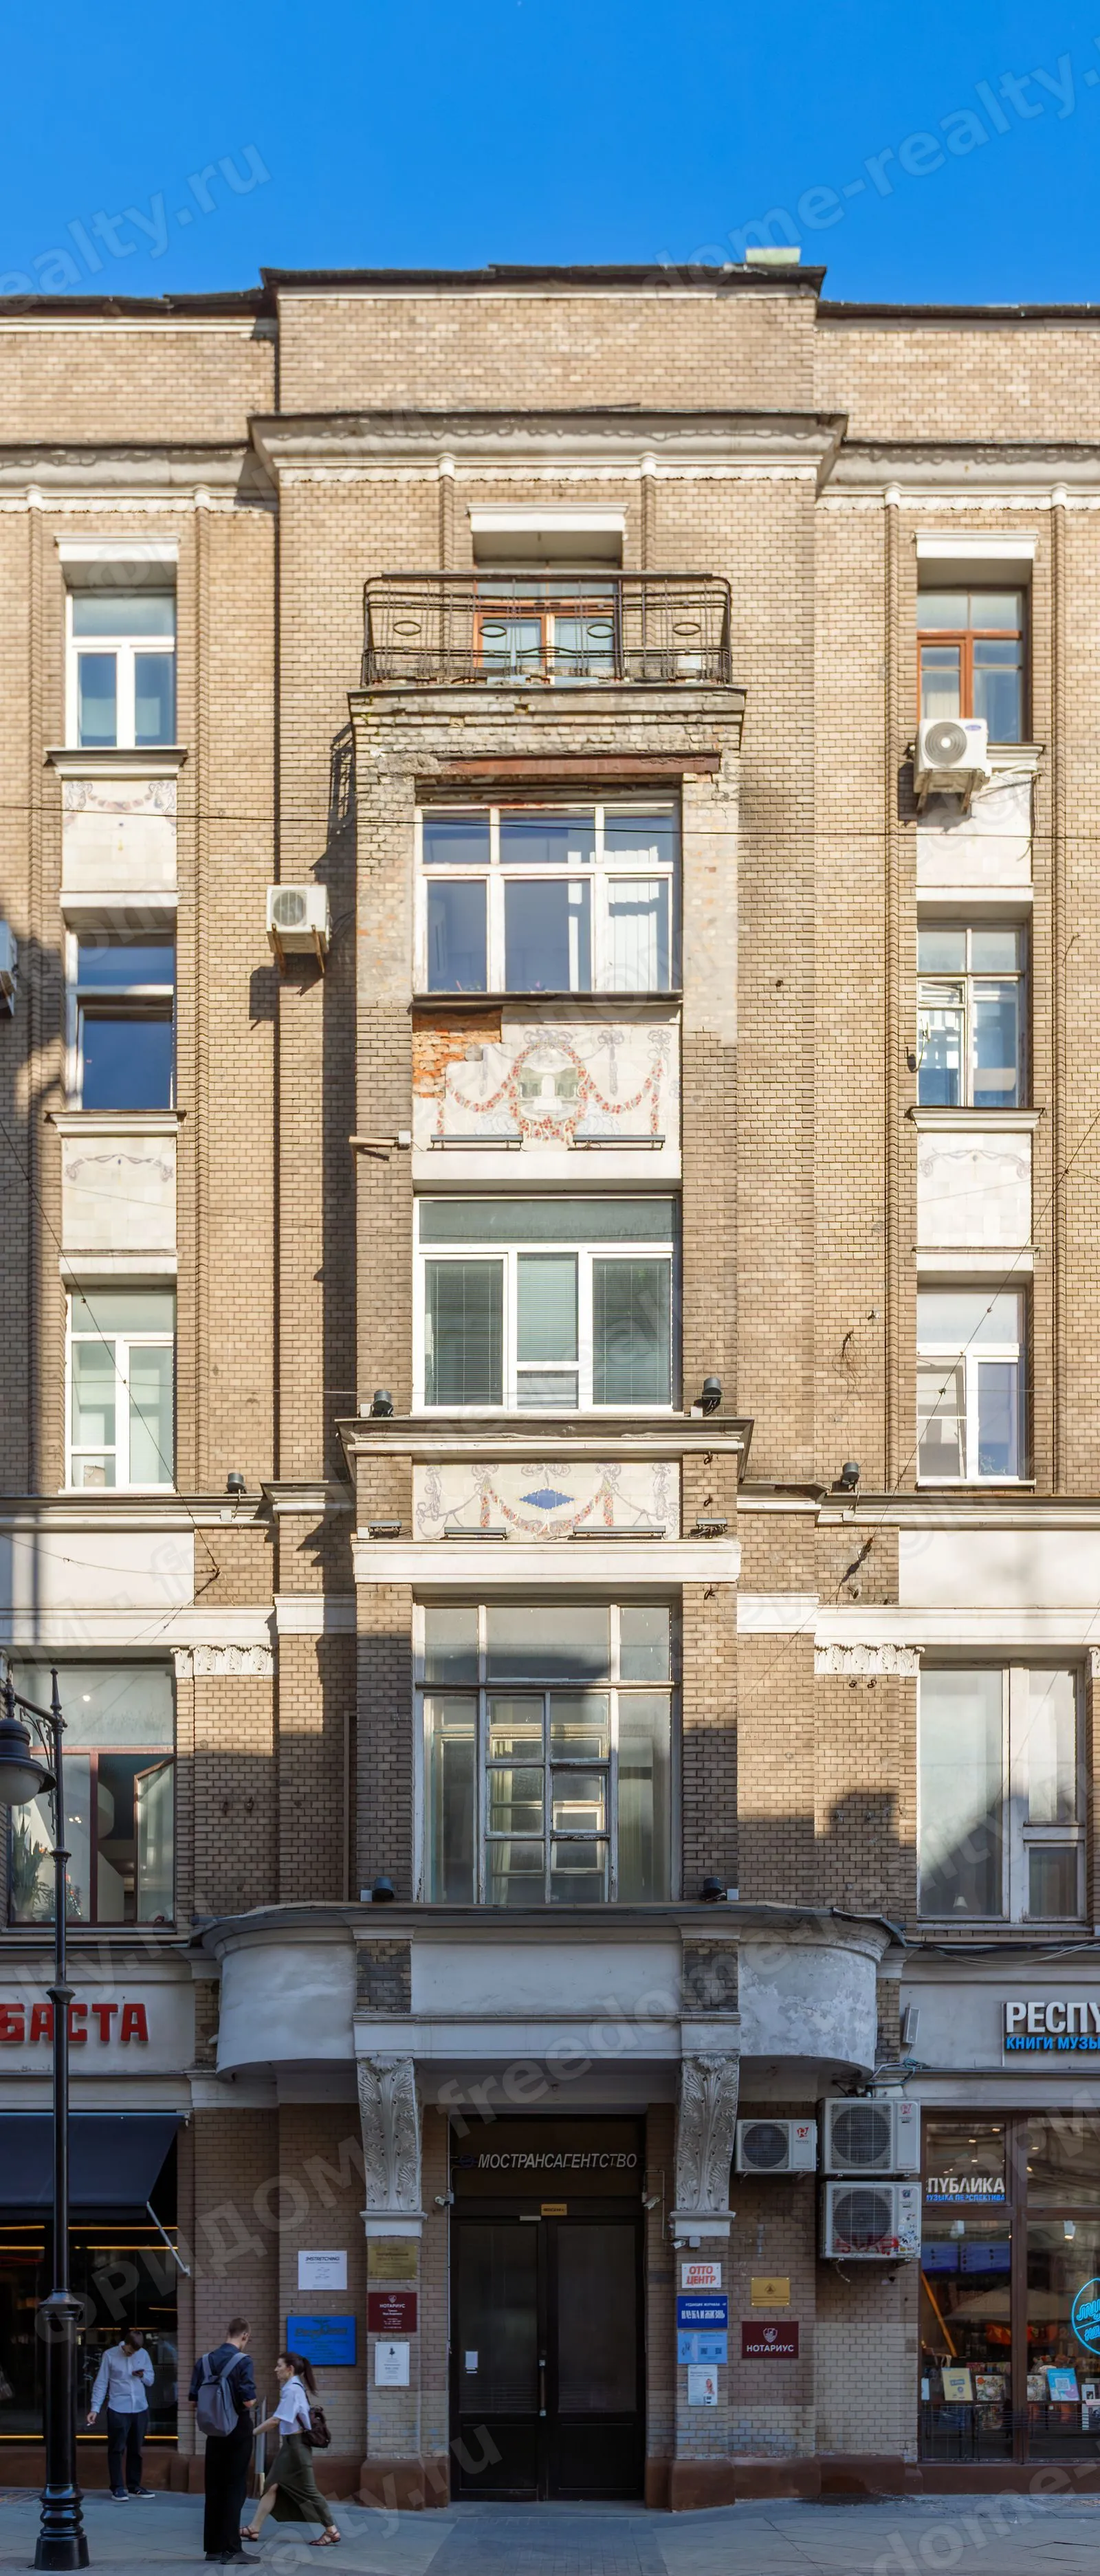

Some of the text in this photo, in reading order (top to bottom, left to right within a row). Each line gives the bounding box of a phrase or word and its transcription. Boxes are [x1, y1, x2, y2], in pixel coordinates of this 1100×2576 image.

[1006, 2036, 1053, 2049] КНИГИ
[478, 2153, 637, 2168] МОСТРАНСАГЕНТСТВО
[926, 2177, 1005, 2193] ПУБЛИКА
[689, 2265, 713, 2274] ОТТО
[686, 2276, 716, 2285] ЦЕНТР
